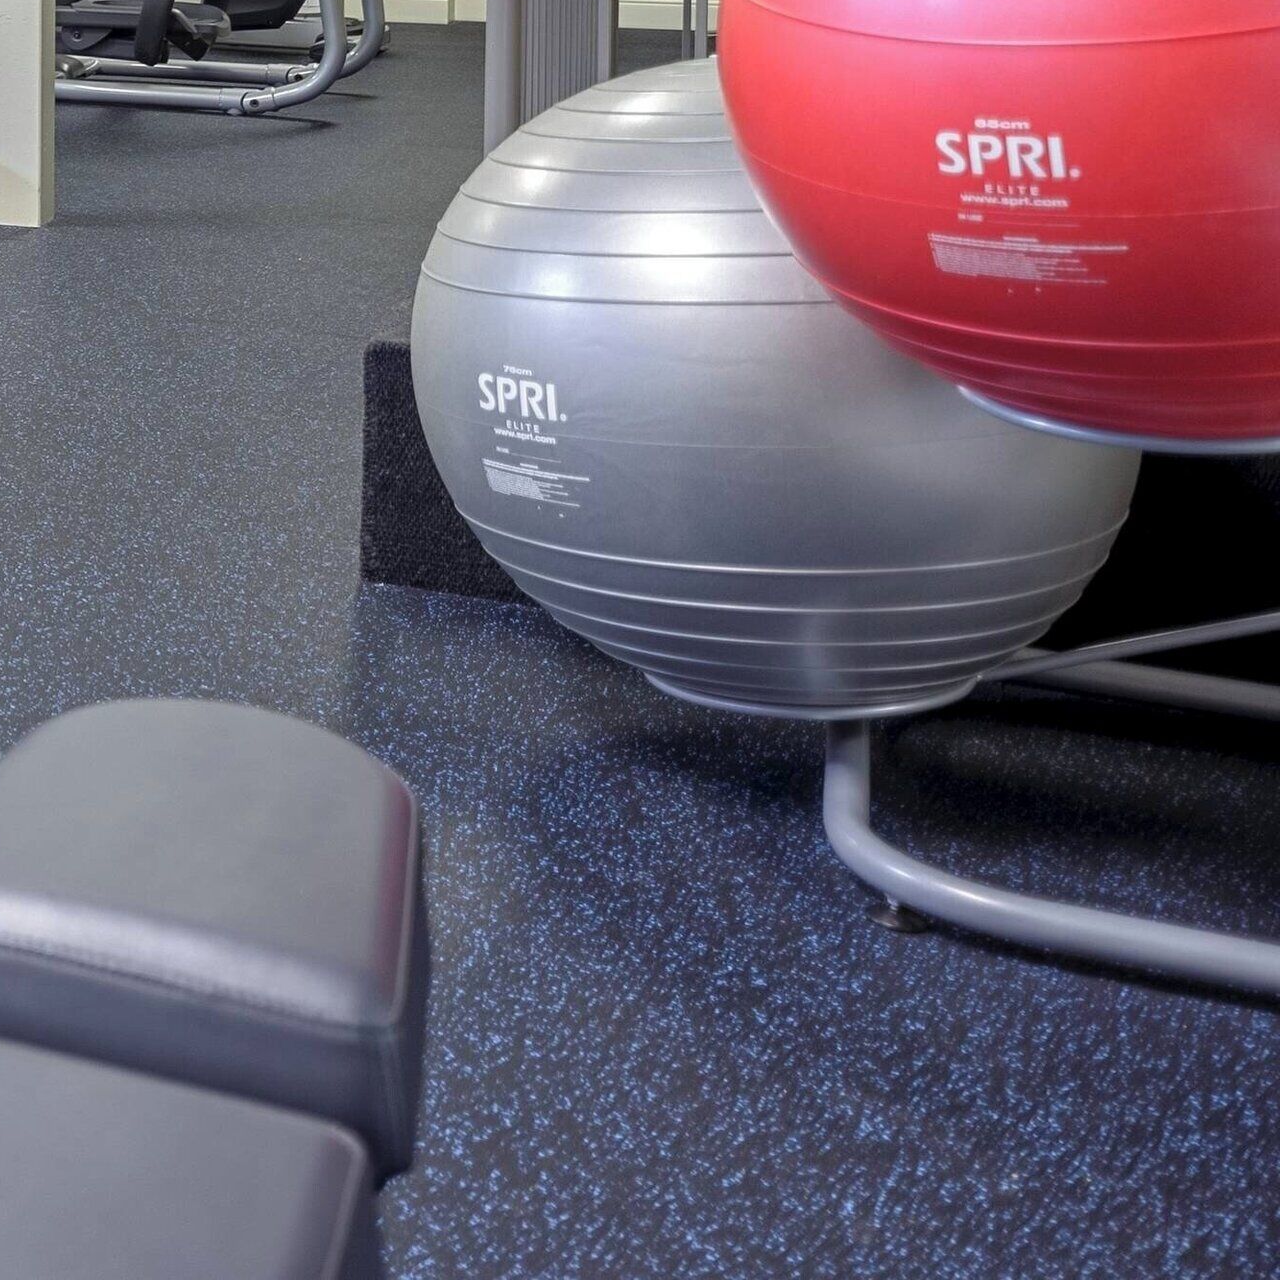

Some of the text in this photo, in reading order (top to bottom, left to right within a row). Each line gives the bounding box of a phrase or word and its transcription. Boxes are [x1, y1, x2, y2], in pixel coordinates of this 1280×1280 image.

[984, 184, 1040, 196] ELITE
[960, 193, 1069, 208] www.spri.com
[506, 419, 541, 433] ELITE
[493, 427, 557, 445] www.spri.com
